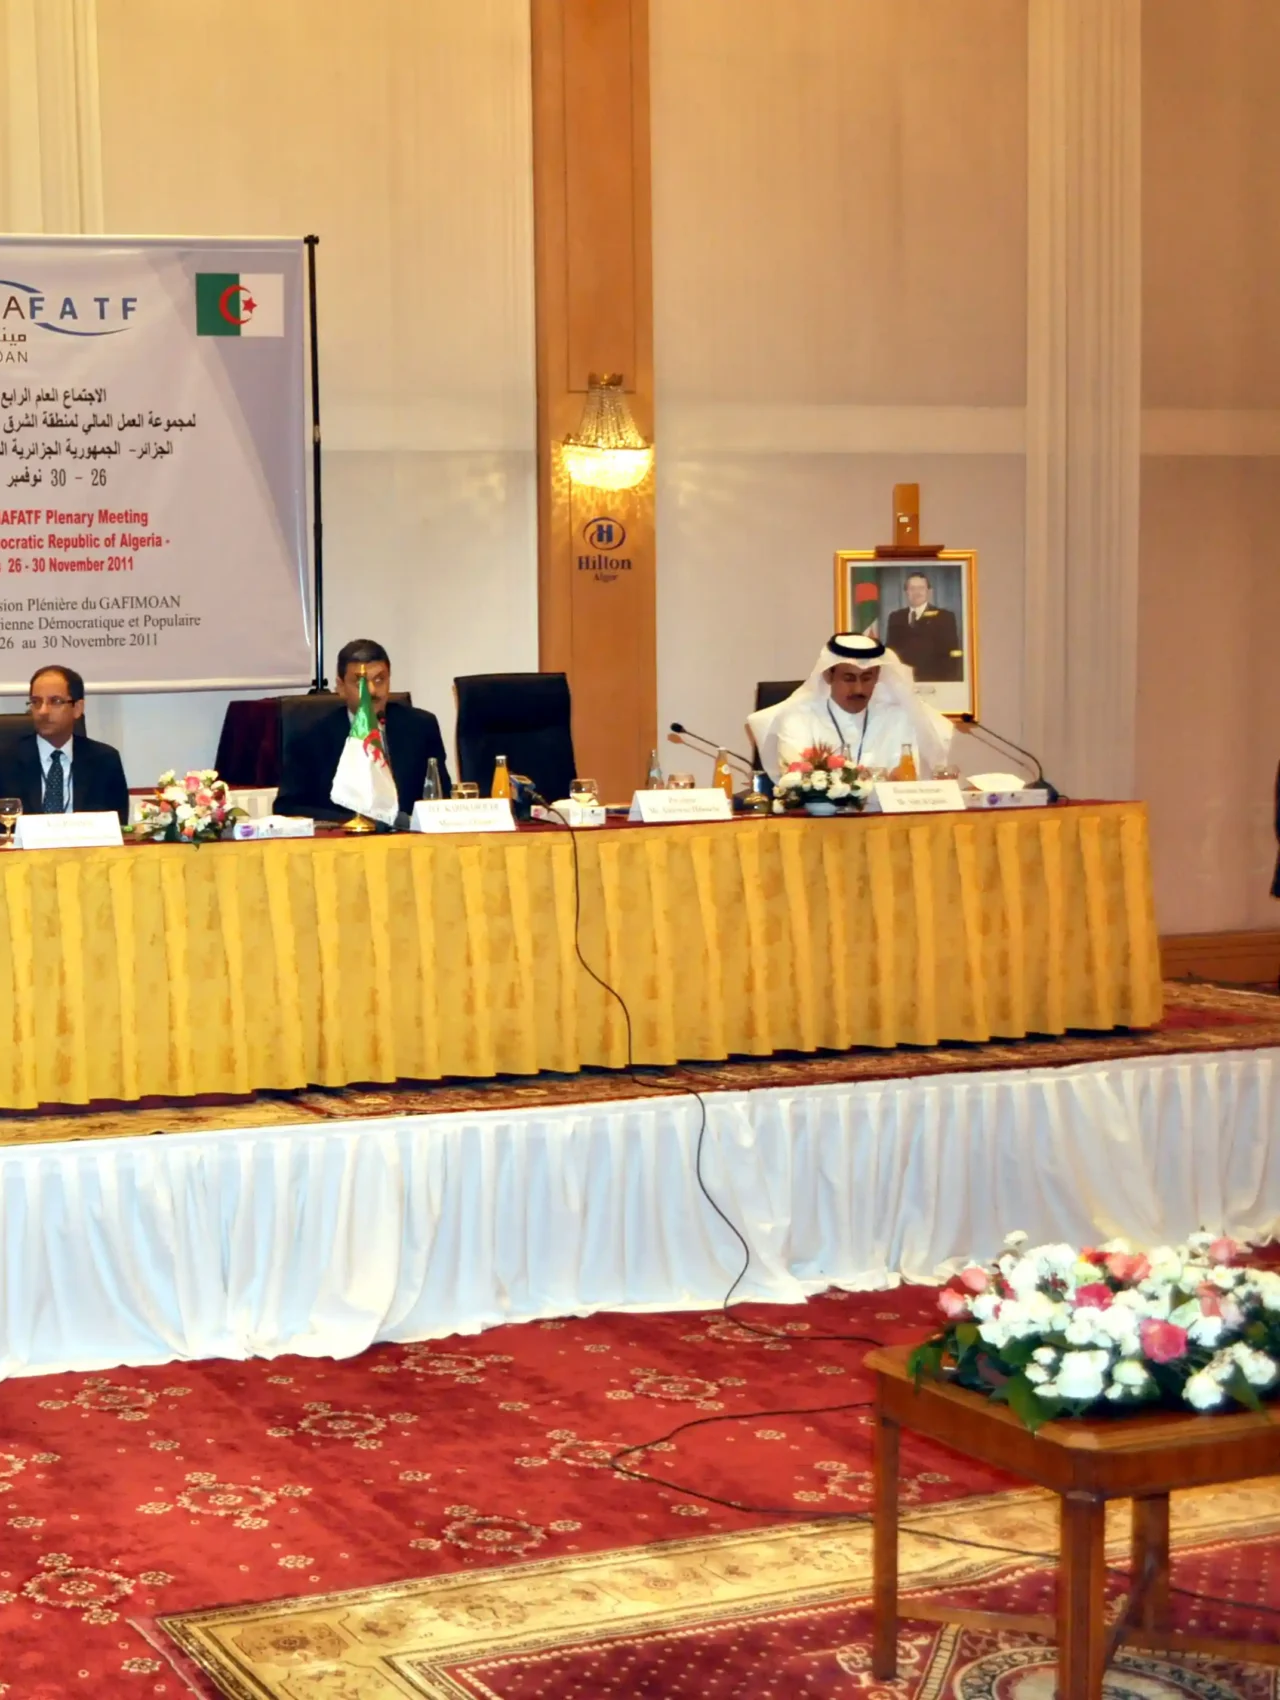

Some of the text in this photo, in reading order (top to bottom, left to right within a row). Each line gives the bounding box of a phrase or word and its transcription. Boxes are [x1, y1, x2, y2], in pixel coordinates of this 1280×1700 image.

[1, 387, 30, 408] الرابع
[36, 388, 58, 408] العام
[63, 387, 107, 409] الاجتماع
[3, 413, 37, 433] الشرق
[42, 411, 79, 427] لمنطقة
[81, 413, 113, 434] المالي
[117, 413, 144, 431] العمل
[148, 411, 196, 431] لمجموعة
[12, 438, 61, 460] الجزائرية
[65, 438, 121, 460] الجمهورية
[7, 466, 42, 487] نوفمبر
[50, 468, 66, 487] 30
[91, 468, 107, 486] 26
[46, 510, 94, 528] Plenary
[98, 509, 148, 527] Meeting
[48, 533, 100, 552] Republic
[104, 533, 116, 548] of
[120, 532, 162, 551] Algeria
[8, 558, 22, 573] 26
[32, 558, 45, 573] 30
[49, 557, 104, 572] November
[108, 556, 133, 571] 2011
[578, 554, 632, 570] Hilton
[27, 597, 78, 612] Plénière
[81, 597, 96, 611] du
[99, 595, 181, 610] GAFIMOAN
[38, 615, 125, 631] Démocratique
[128, 616, 140, 628] et
[143, 613, 201, 631] Populaire
[21, 639, 36, 649] au
[42, 635, 58, 649] 30
[61, 634, 126, 648] Novembre
[129, 633, 158, 647] 2011
